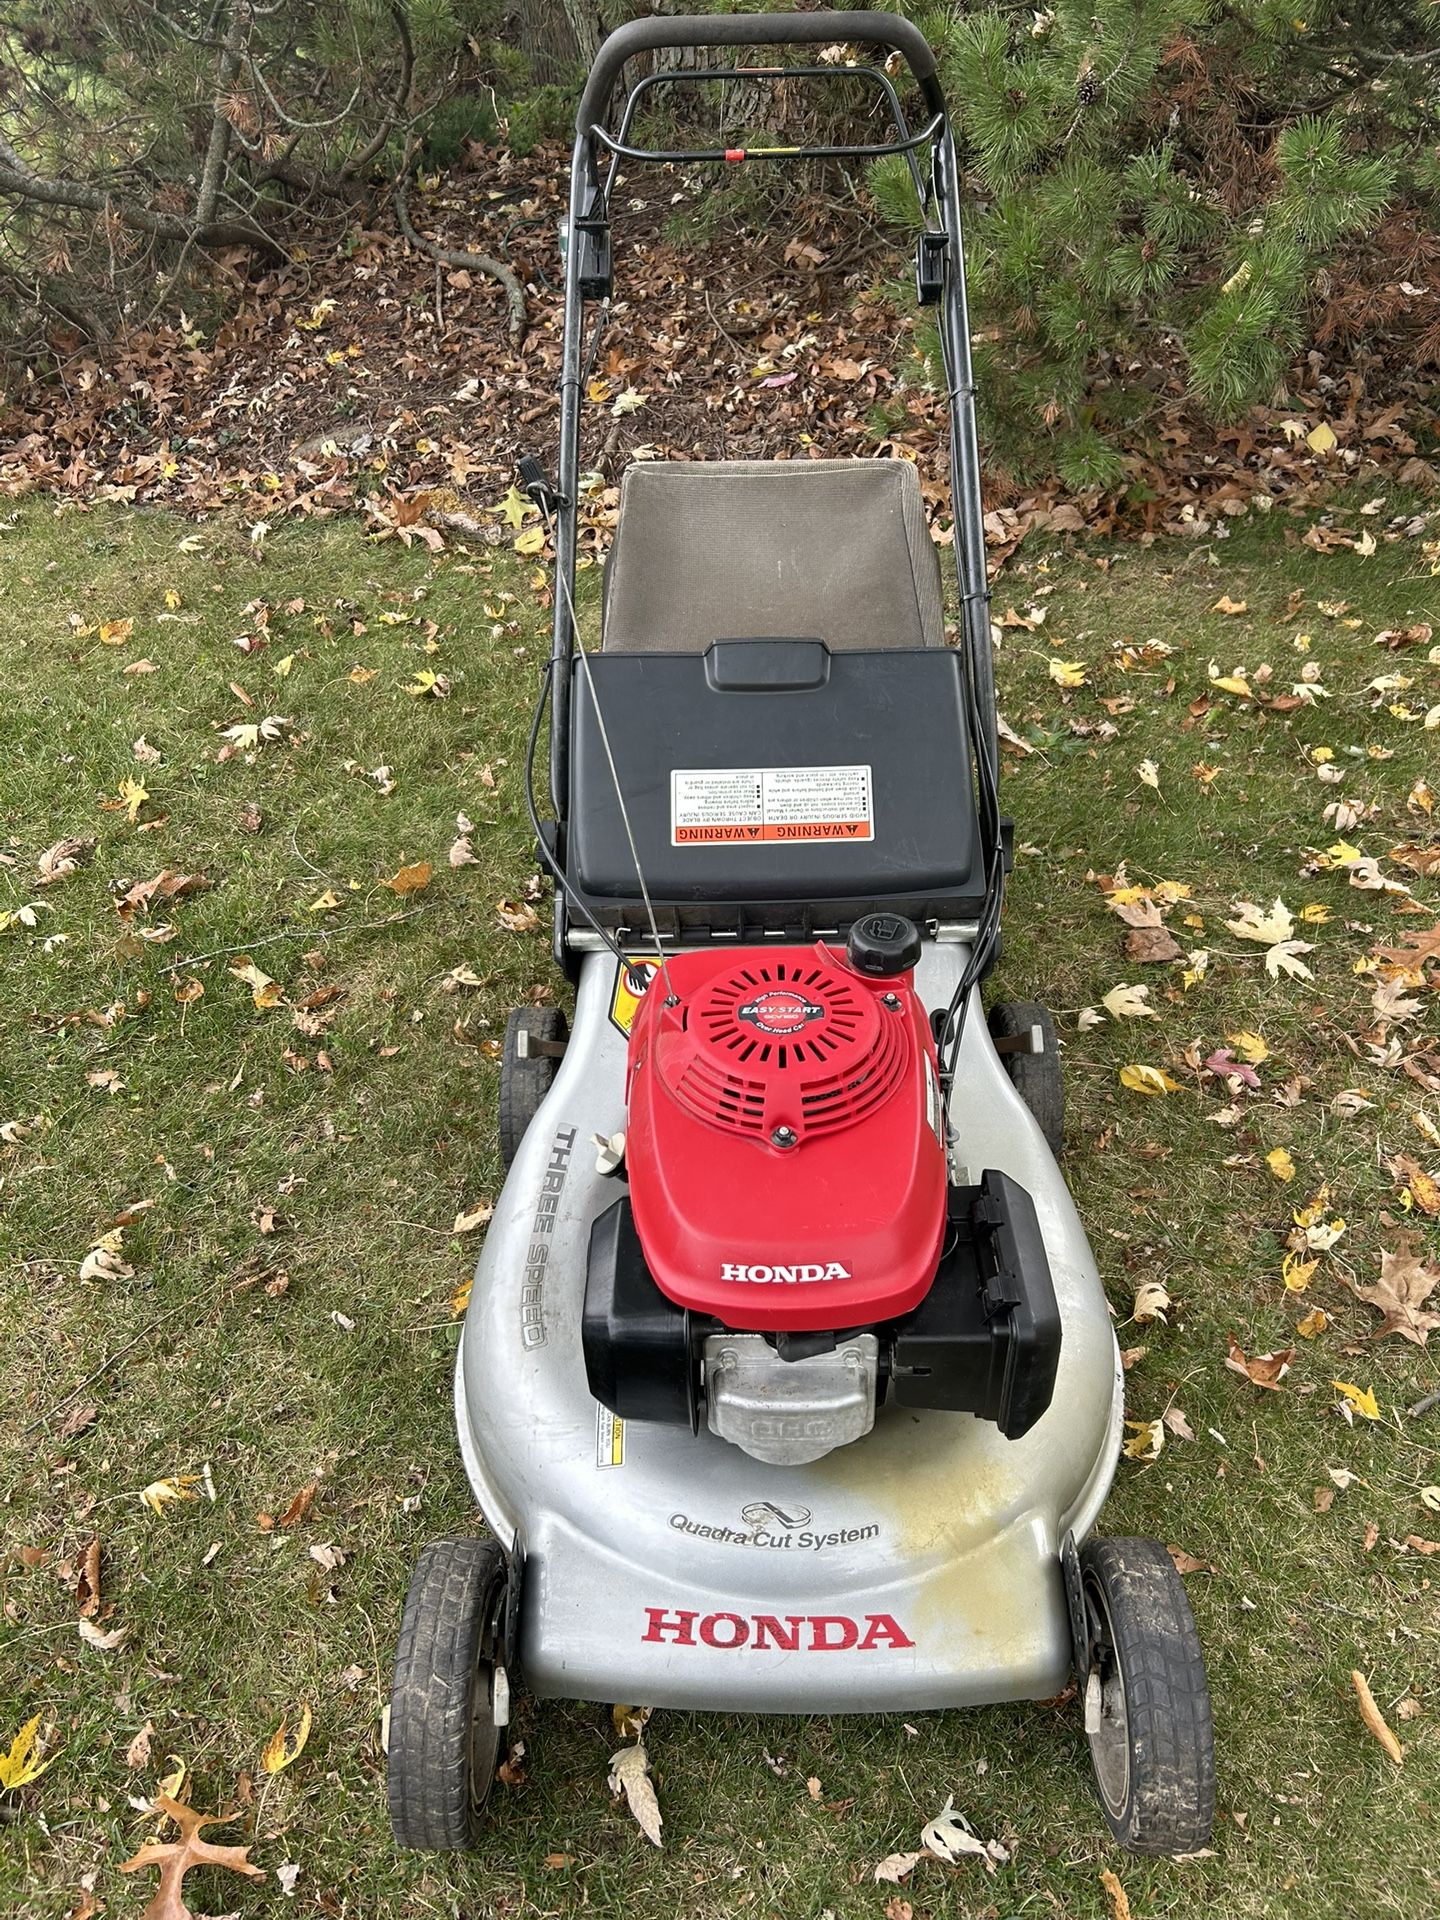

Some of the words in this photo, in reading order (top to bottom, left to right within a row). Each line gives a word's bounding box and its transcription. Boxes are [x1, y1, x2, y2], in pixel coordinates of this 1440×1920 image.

[679, 828, 744, 839] WARNING
[777, 826, 843, 837] WARNING
[769, 992, 807, 1003] Performance
[756, 1022, 772, 1031] Over
[533, 1129, 577, 1233] THREE
[721, 1262, 851, 1283] HONDA
[521, 1243, 548, 1347] SPEED
[669, 1513, 748, 1545] Quadra
[753, 1531, 792, 1548] Cut
[797, 1522, 880, 1551] System
[641, 1608, 916, 1650] HONDA
